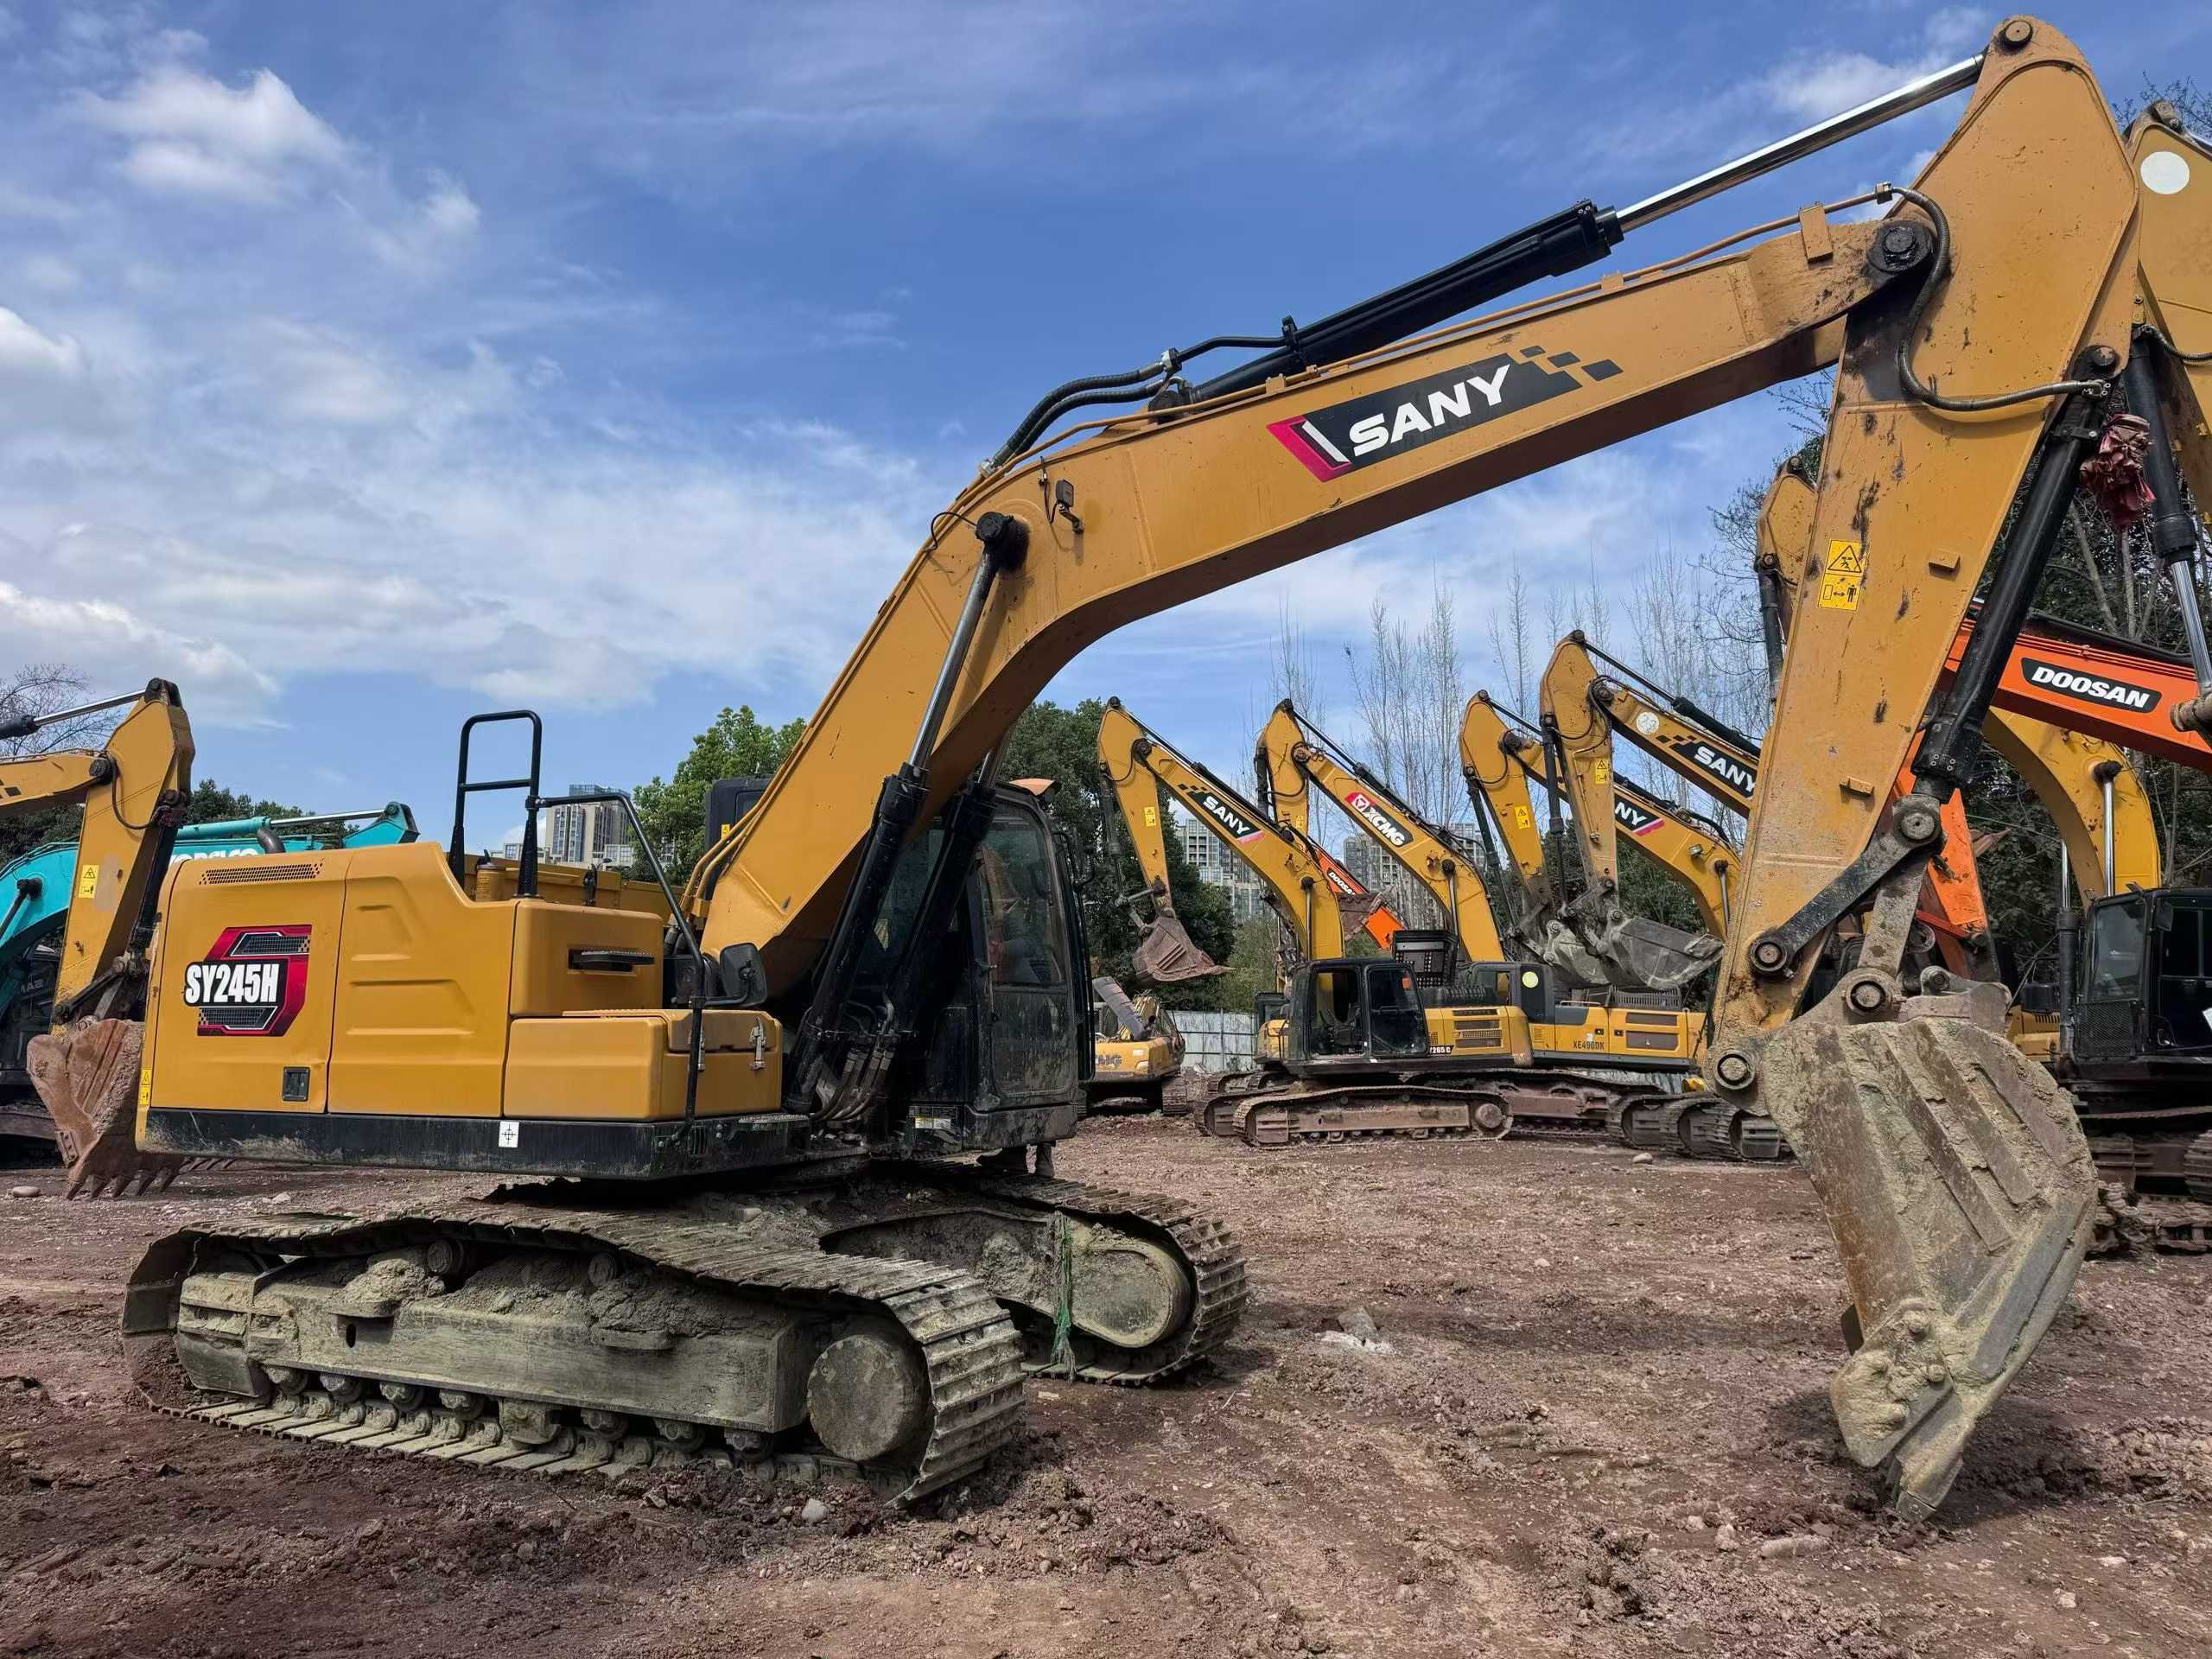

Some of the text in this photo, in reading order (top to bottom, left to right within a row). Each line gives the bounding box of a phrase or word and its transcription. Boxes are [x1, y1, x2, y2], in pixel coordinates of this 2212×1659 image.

[1349, 364, 1510, 457] SANY
[2031, 666, 2150, 708] DOOSAN
[1694, 746, 1757, 792] SANY
[1203, 795, 1251, 835] SANY
[1362, 806, 1405, 846] XCMG
[1614, 801, 1648, 826] NY
[185, 963, 280, 1003] SY245H
